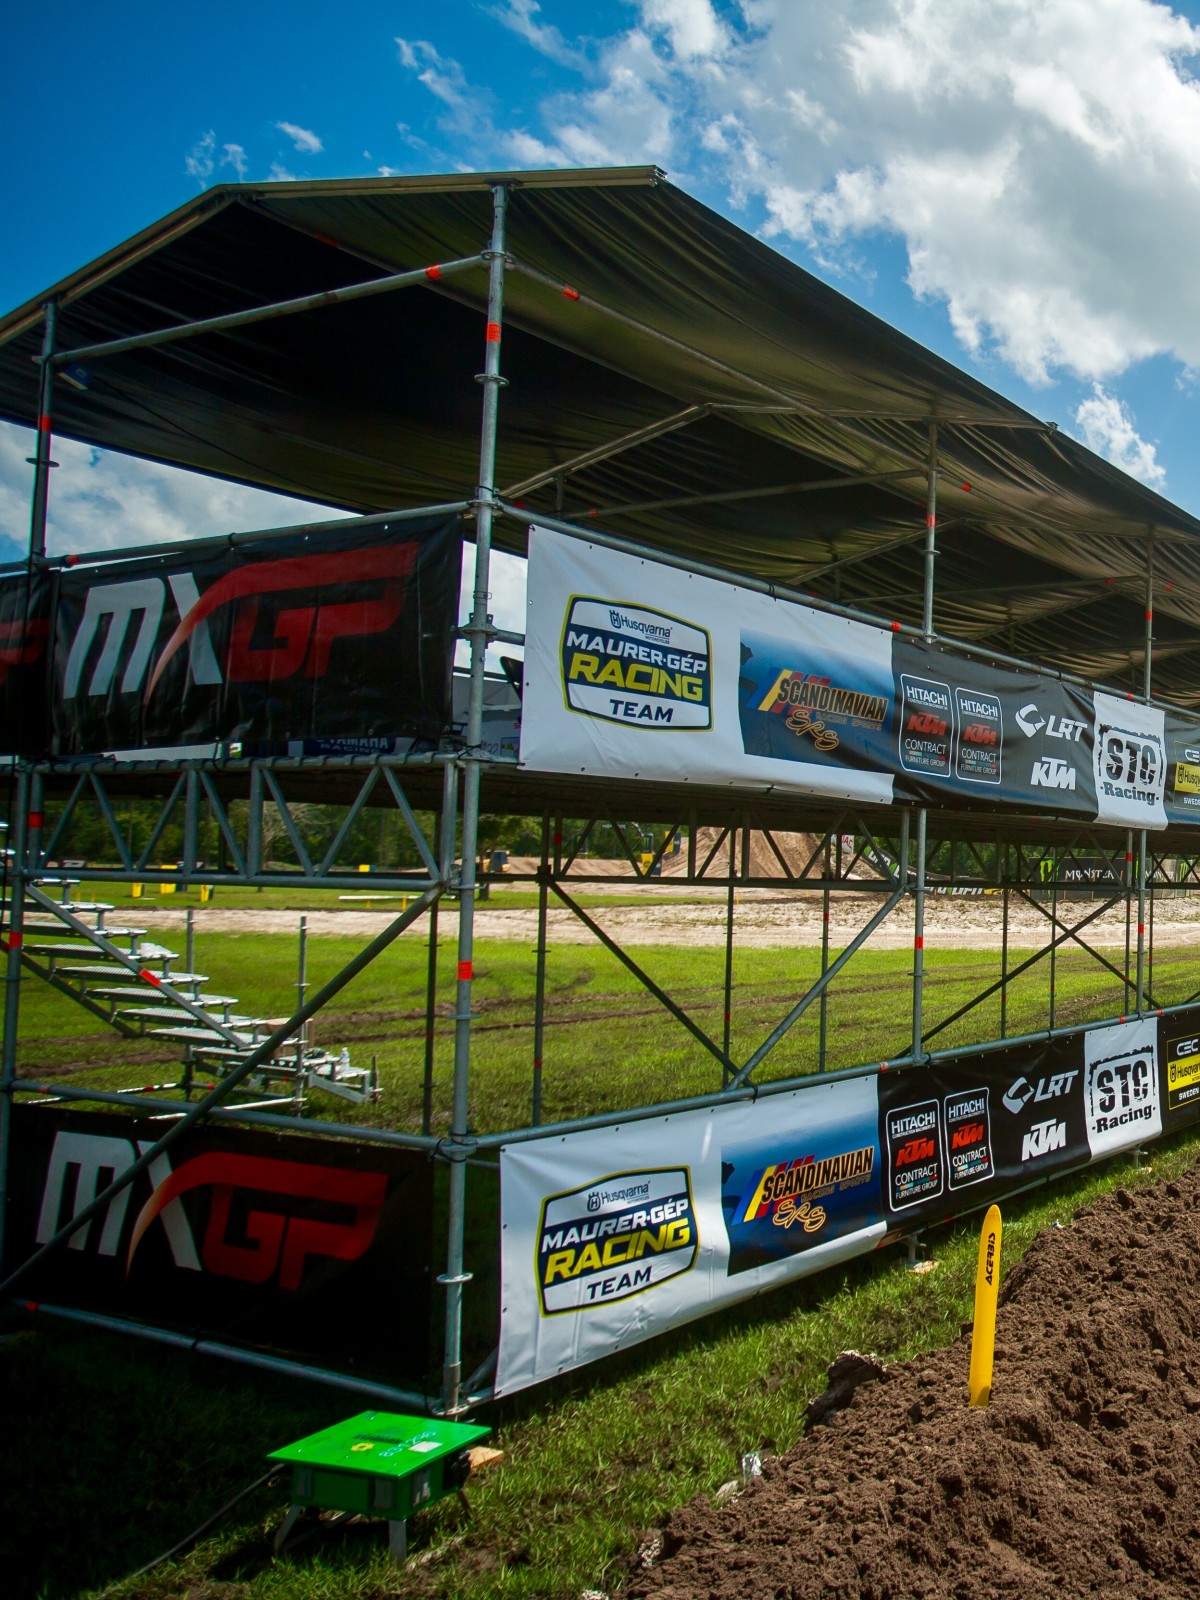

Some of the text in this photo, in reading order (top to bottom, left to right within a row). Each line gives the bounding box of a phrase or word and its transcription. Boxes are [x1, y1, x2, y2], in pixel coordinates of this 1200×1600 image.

[64, 541, 420, 704] MXGP
[621, 615, 671, 638] Husqvarna
[569, 652, 702, 702] RACING
[777, 678, 889, 722] SCANDINAVIAN
[906, 685, 948, 706] HITACHI
[610, 699, 673, 722] TEAM
[960, 699, 998, 717] HITACHI
[907, 711, 947, 736] KTM
[963, 722, 997, 745] KTM
[1045, 715, 1088, 742] LRT
[905, 738, 947, 754] CONTRACT
[961, 748, 997, 762] CONTRACT
[905, 754, 945, 767] FURNITURE GROUP
[961, 764, 997, 775] FURNITURE GROUP
[1030, 756, 1076, 790] KTM
[1034, 1069, 1079, 1103] LRT
[1179, 1087, 1199, 1100] SWEDEN
[948, 1098, 984, 1118] HITACHI
[891, 1110, 935, 1134] HITACHI
[952, 1122, 983, 1149] KTM
[1021, 1118, 1066, 1162] KTM
[896, 1137, 935, 1167] KTM
[952, 1146, 987, 1167] CONTRACT
[761, 1145, 874, 1204] SCANDINAVIAN
[895, 1163, 938, 1186] CONTRACT
[954, 1162, 989, 1180] FURNITURE GROUP
[601, 1183, 649, 1206] Husqvarna
[896, 1179, 938, 1199] FURNITURE GROUP
[35, 1131, 389, 1291] MXGP
[544, 1217, 691, 1286] RACING
[985, 1232, 996, 1286] ACERBIS
[587, 1266, 652, 1300] TEAM
